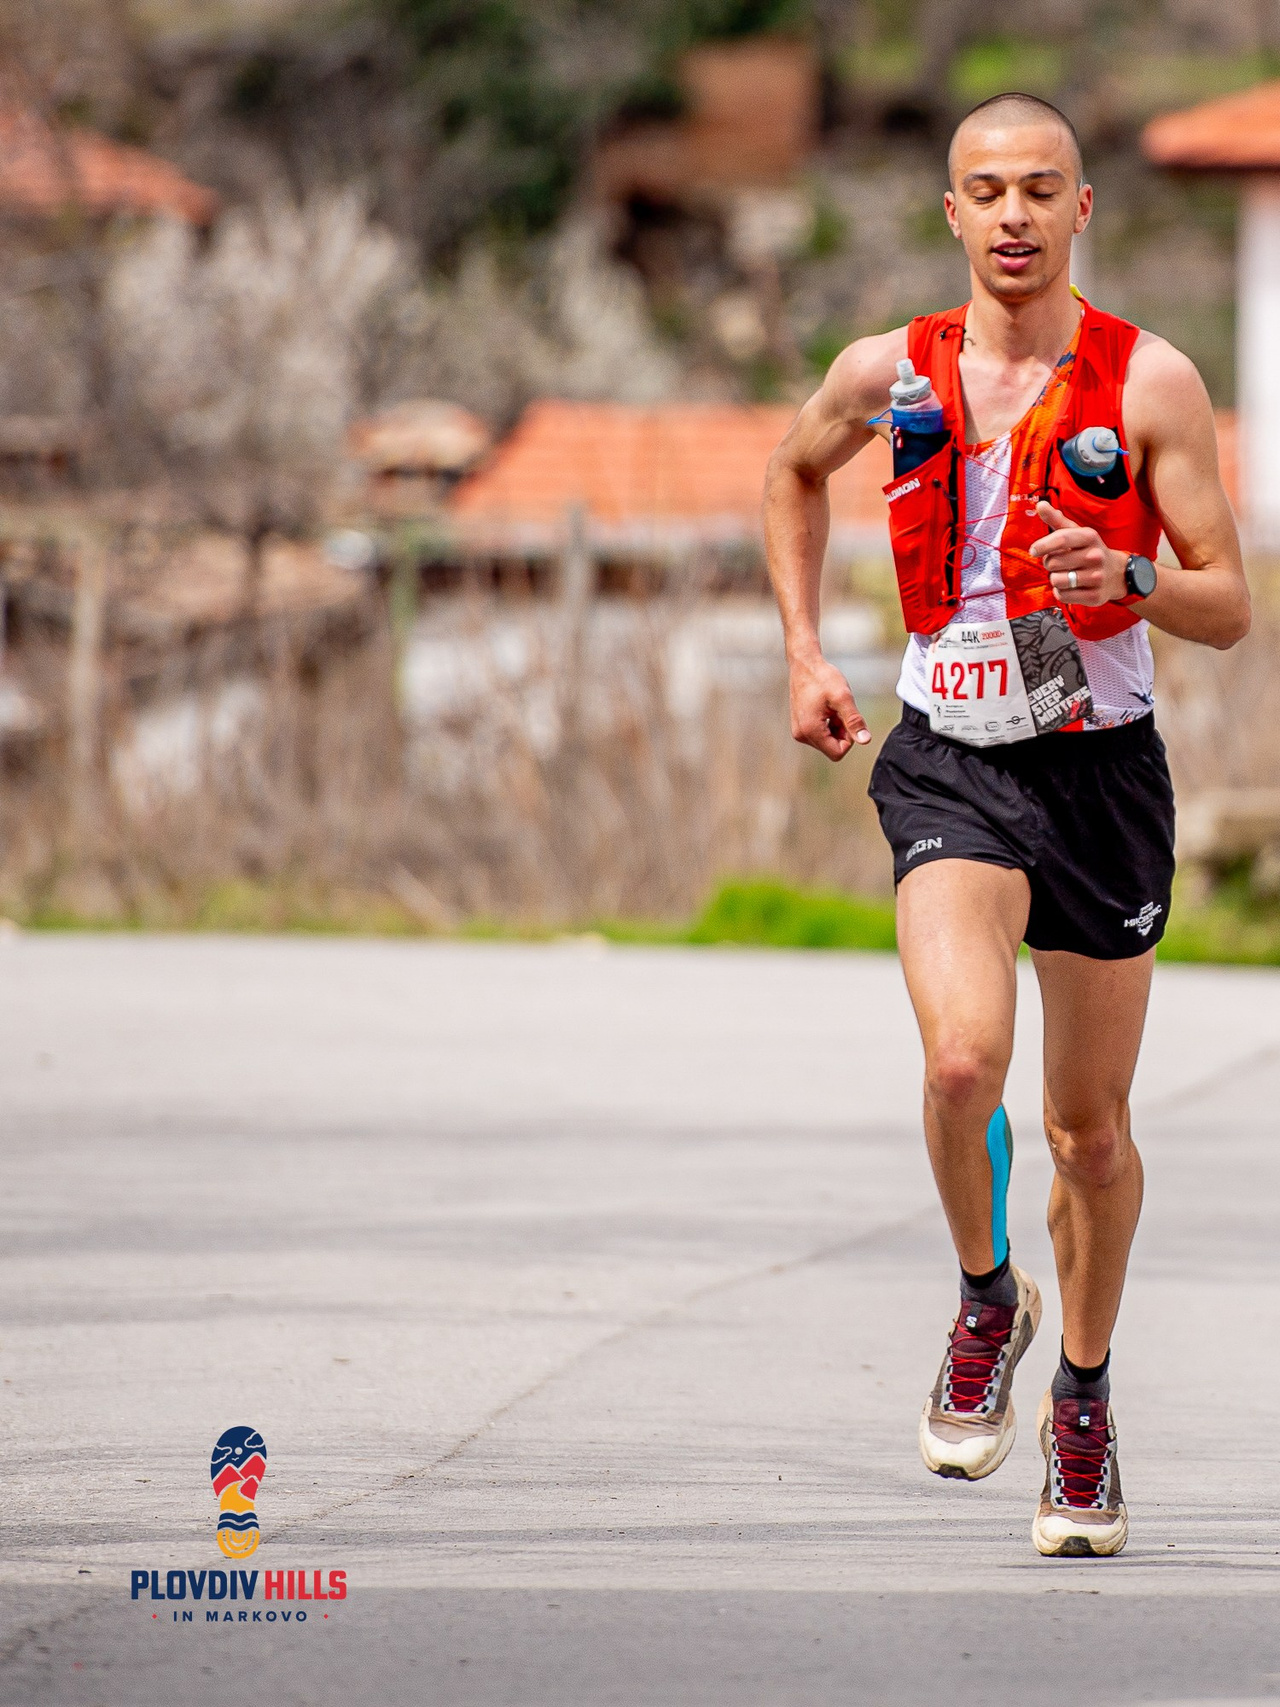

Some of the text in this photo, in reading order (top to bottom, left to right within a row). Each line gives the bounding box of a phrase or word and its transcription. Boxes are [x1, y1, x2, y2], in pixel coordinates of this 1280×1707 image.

[932, 658, 1008, 699] 4277
[1027, 674, 1064, 706] EVERY
[1031, 690, 1062, 716] STEP
[1037, 685, 1092, 726] MATTERS
